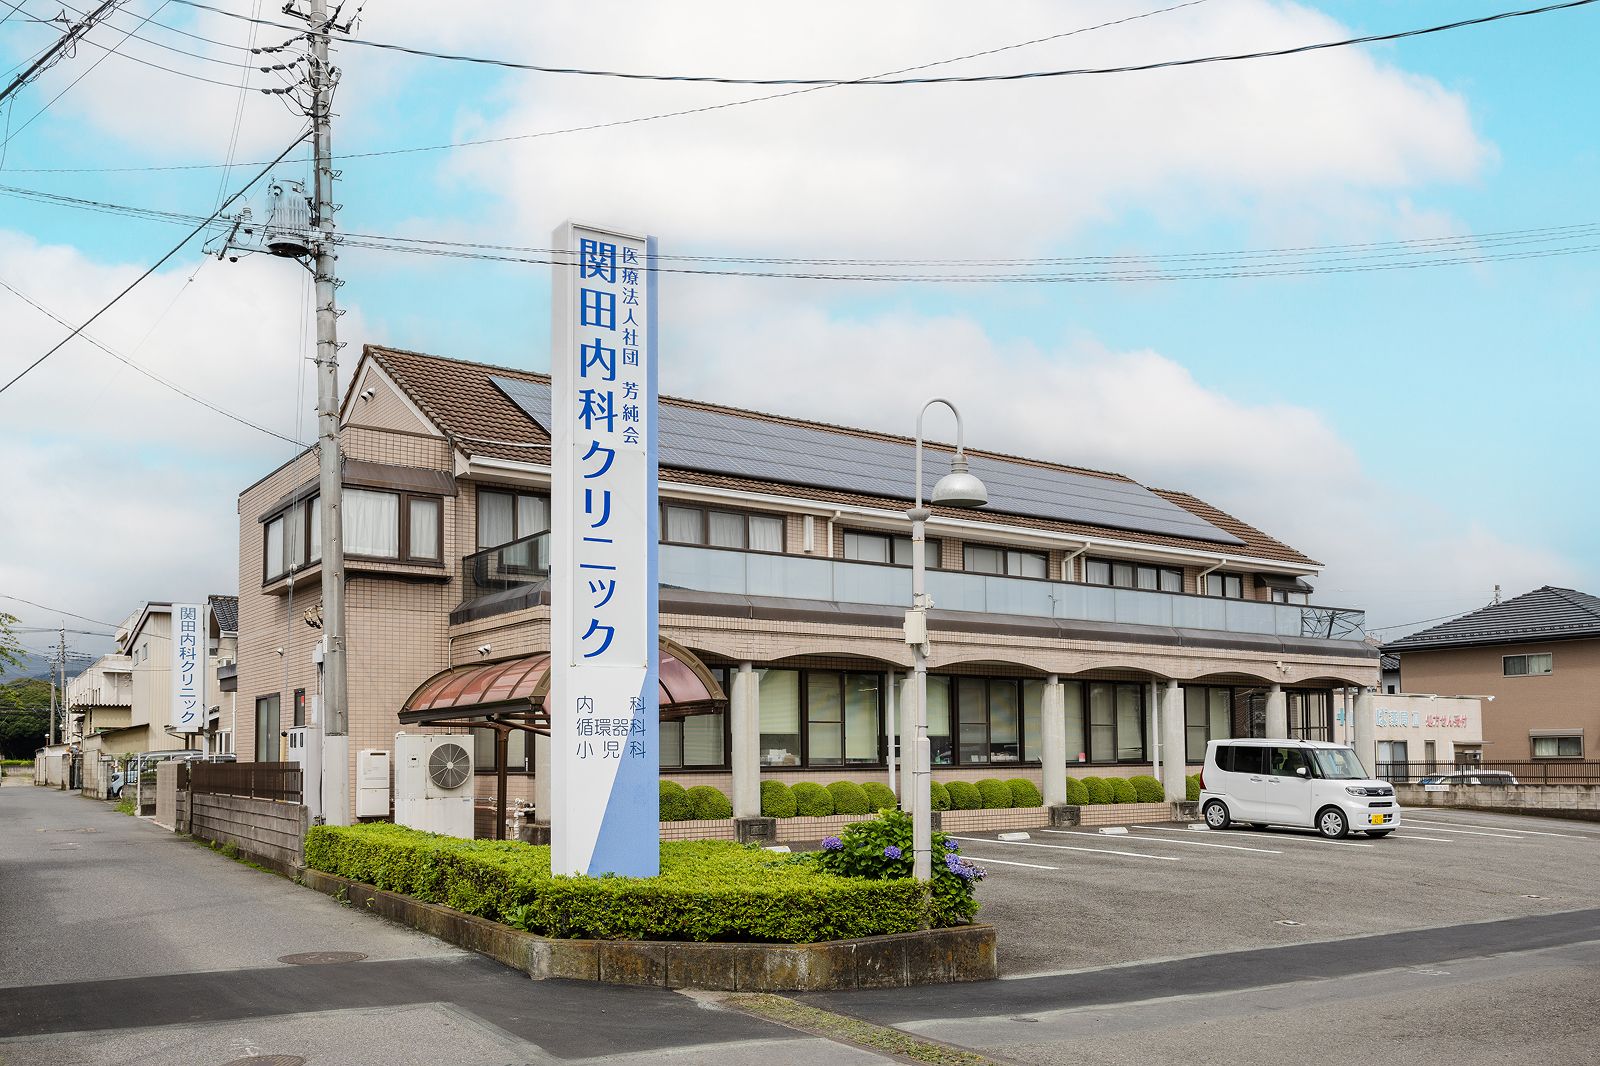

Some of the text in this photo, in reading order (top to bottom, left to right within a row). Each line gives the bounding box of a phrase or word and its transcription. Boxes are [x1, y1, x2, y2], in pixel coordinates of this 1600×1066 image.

[622, 246, 639, 444] 医療法人社団 芳純会
[578, 238, 618, 658] 関田内科クリニック
[179, 607, 197, 723] 関田内科クリニック
[576, 718, 646, 737] 循環器科
